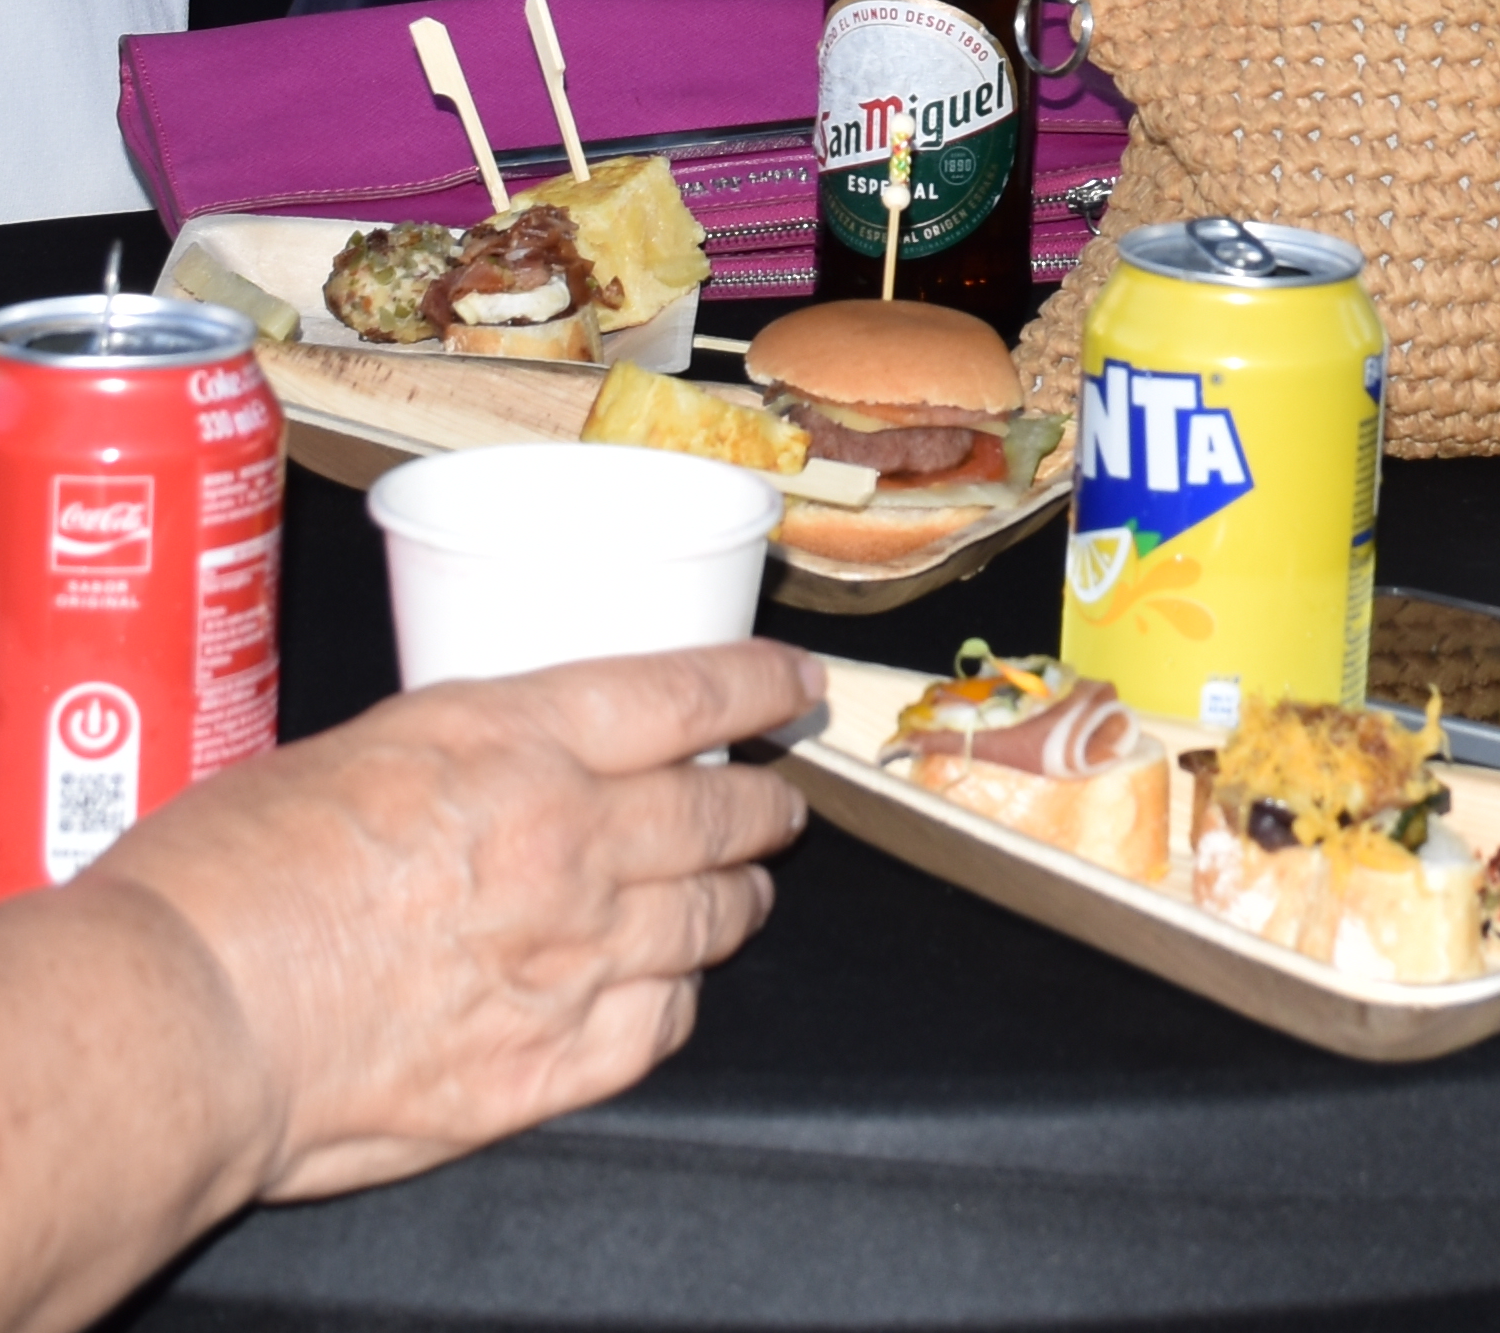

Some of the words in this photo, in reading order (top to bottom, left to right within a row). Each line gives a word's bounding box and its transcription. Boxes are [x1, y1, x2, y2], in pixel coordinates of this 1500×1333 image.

[838, 17, 851, 31] EL
[852, 7, 899, 25] MUNDO
[905, 9, 956, 37] DESDE
[957, 31, 989, 63] 1890
[944, 158, 972, 173] 1890
[847, 174, 939, 200] ESPEAL
[859, 226, 920, 245] ESPEAL
[923, 208, 969, 240] ORIGEN
[1082, 364, 1247, 493] NTA
